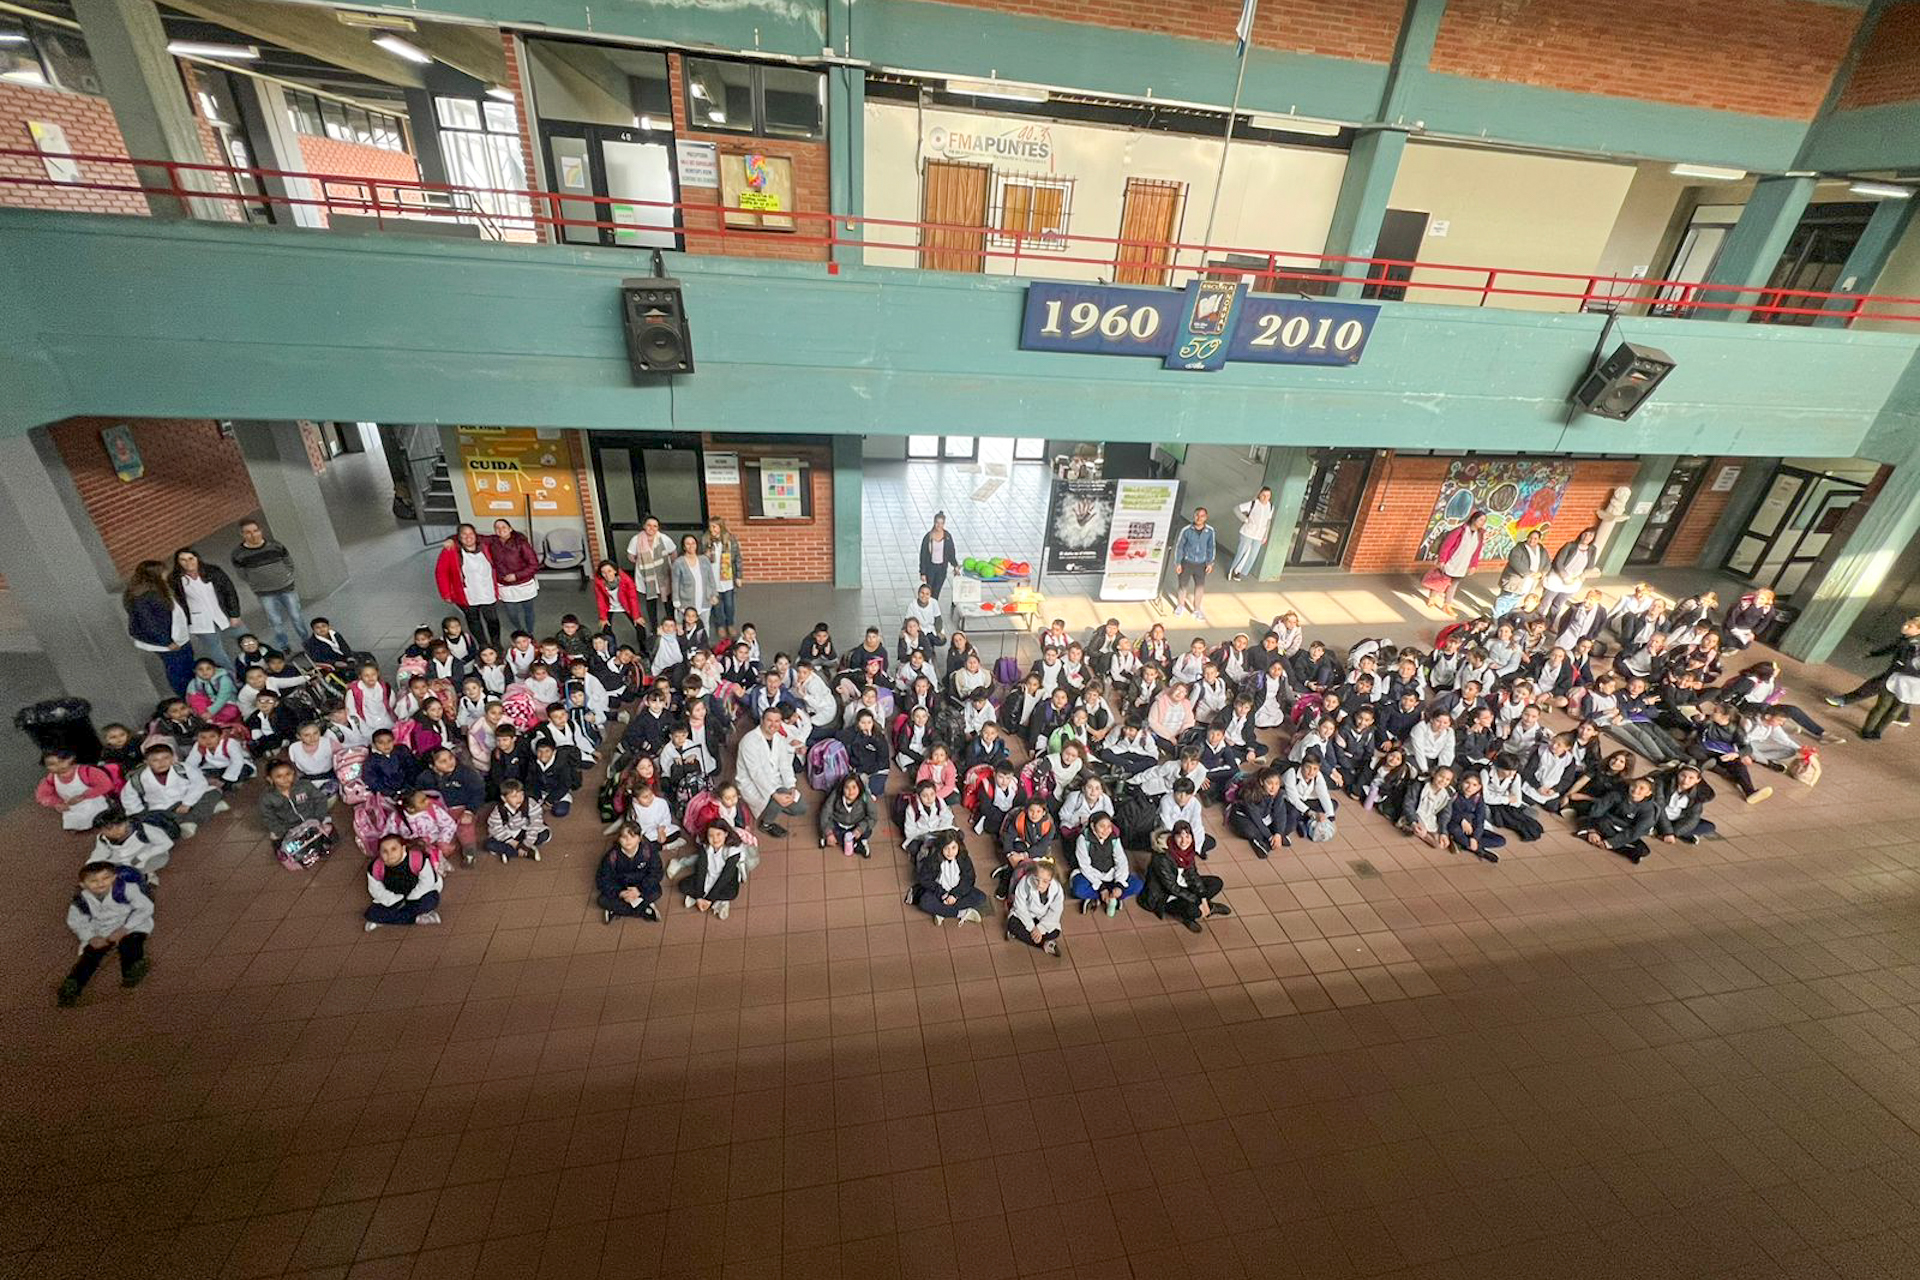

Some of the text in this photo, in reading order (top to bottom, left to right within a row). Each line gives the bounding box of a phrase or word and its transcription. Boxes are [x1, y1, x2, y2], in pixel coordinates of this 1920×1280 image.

[1041, 301, 1159, 338] 1960
[1216, 293, 1232, 331] NORMAL
[1180, 337, 1222, 359] 50
[1250, 315, 1363, 350] 2010
[470, 460, 519, 470] CUIDA
